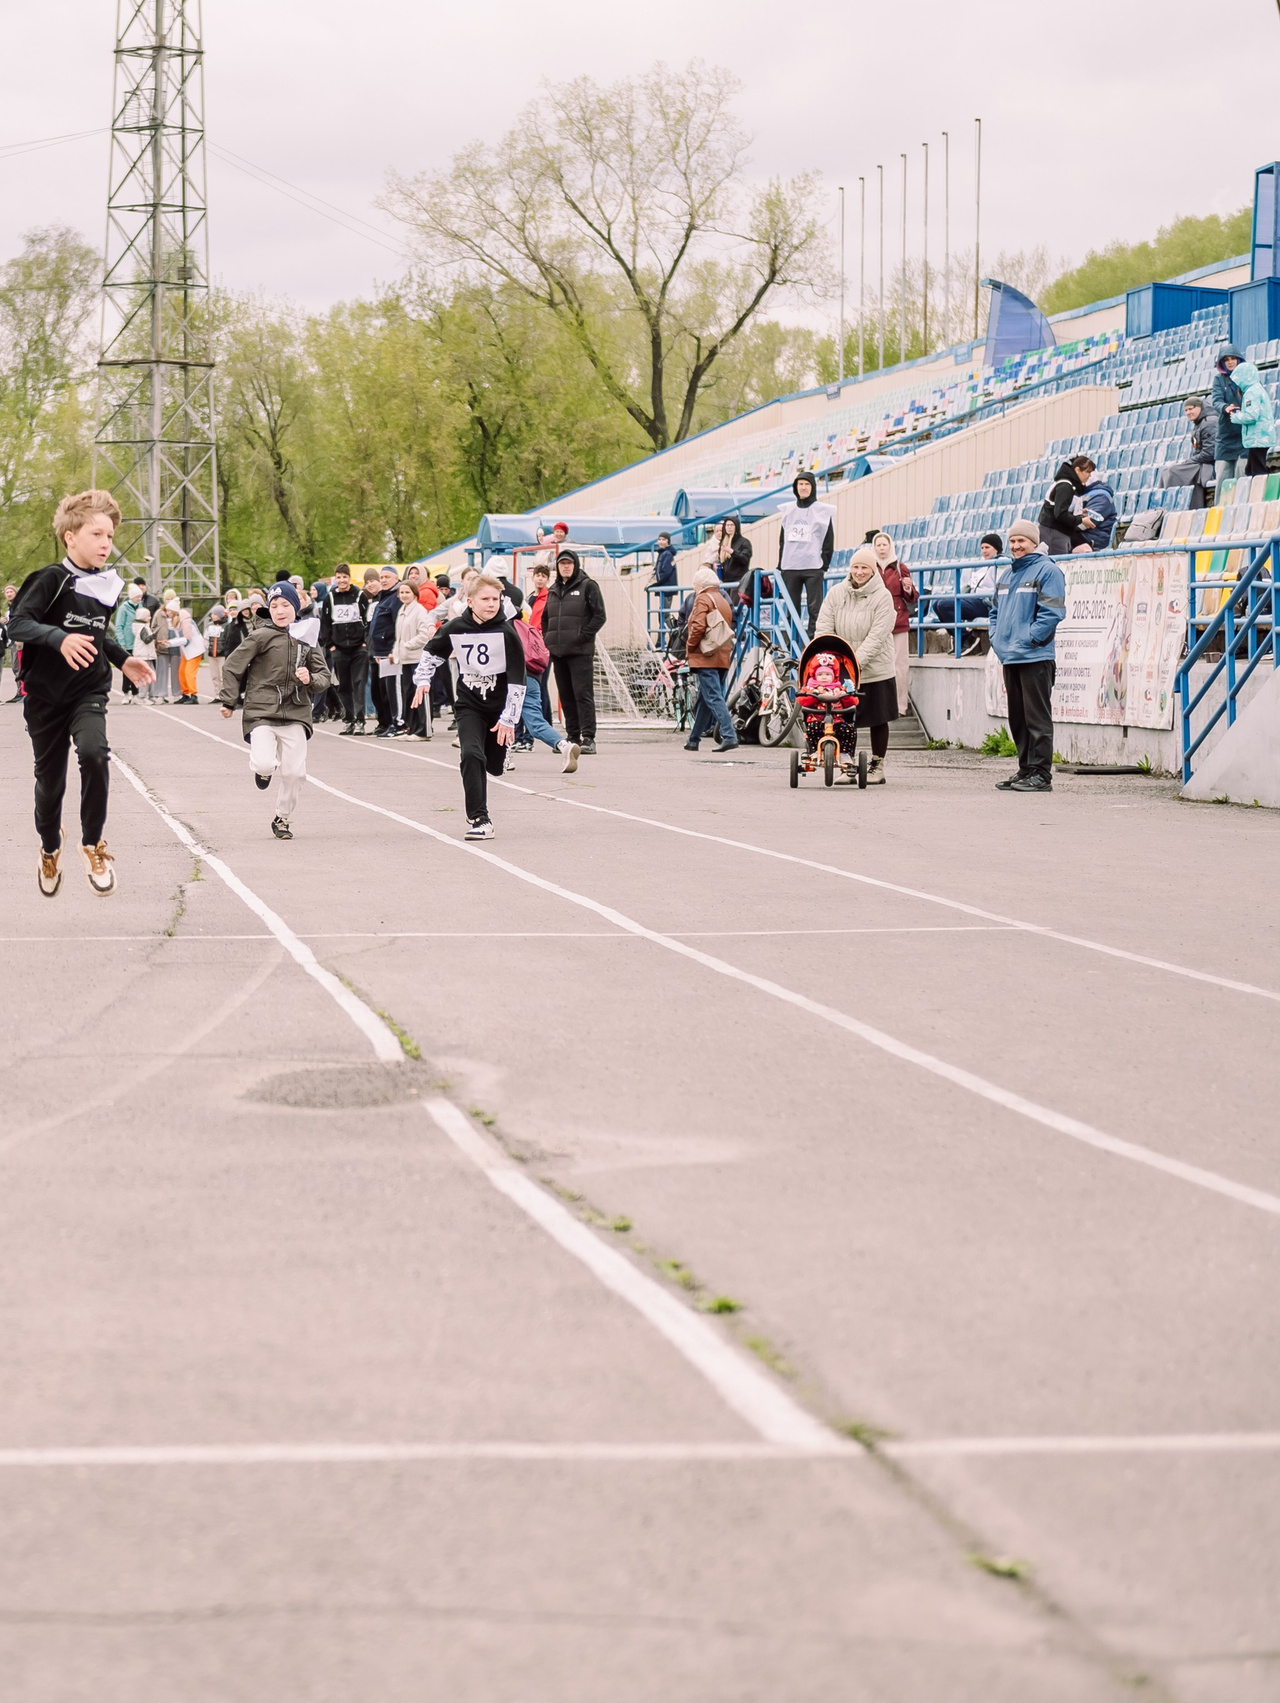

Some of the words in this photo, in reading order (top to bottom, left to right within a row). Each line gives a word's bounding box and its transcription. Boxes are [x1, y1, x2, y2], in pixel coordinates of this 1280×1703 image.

[792, 527, 805, 538] 34
[337, 608, 350, 619] 24
[1072, 600, 1107, 620] 2025-2026
[461, 643, 490, 665] 78
